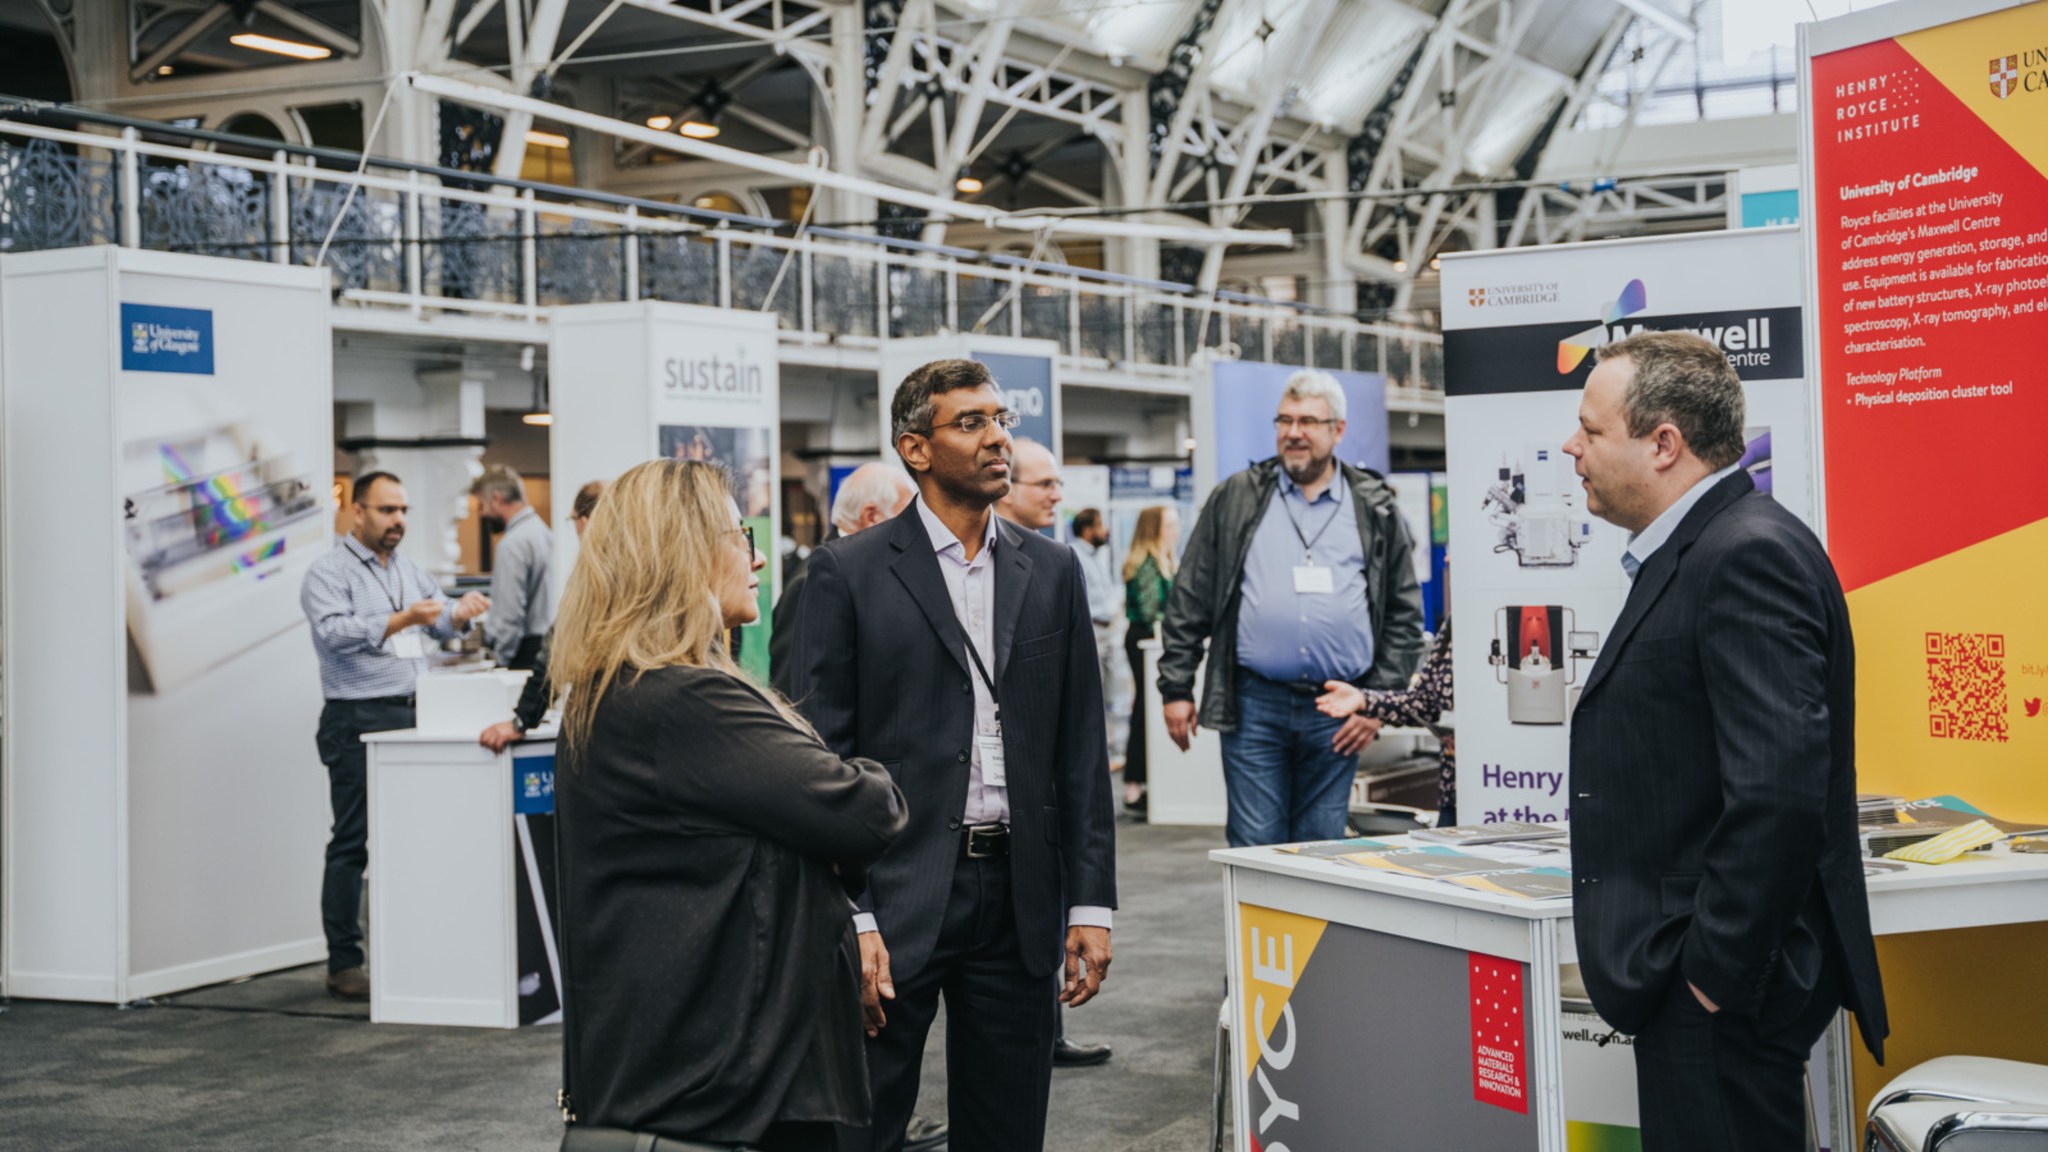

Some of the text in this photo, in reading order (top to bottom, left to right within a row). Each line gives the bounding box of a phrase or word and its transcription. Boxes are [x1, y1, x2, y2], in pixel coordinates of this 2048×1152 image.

[1836, 75, 1888, 98] HENRY
[1836, 98, 1887, 120] ROYCE
[1837, 114, 1919, 143] INSTITUTE
[1840, 165, 1978, 201] University of Cambridge
[1841, 192, 2003, 230] Royce facilities at the University
[1841, 215, 2000, 250] of Cambridge's Maxwell Centre
[1842, 228, 2047, 271] address energy generation, storage, and
[1487, 282, 1558, 295] UNIVERSITY OF
[1842, 280, 1862, 292] use.
[1863, 271, 1917, 291] Equipment
[1919, 268, 1927, 282] is
[1929, 262, 1974, 280] available
[1976, 260, 1993, 274] for
[1488, 292, 1559, 307] CAMBRIDGE
[1843, 298, 1854, 313] of
[1856, 299, 1876, 312] new
[1878, 292, 1914, 309] battery
[1916, 285, 1972, 304] structures,
[1974, 282, 2003, 298] X-ray
[1844, 317, 1911, 336] spectroscopy,
[1913, 311, 1940, 327] X-ray
[1942, 303, 2011, 323] tomography,
[2013, 298, 2034, 314] and
[1612, 317, 1770, 351] Mwell
[1845, 335, 1926, 355] characterisation.
[665, 350, 761, 394] sustain
[1723, 351, 1771, 368] entre
[1846, 365, 1942, 386] Technology Platform
[1855, 380, 2013, 408] Physical deposition cluster tool
[1483, 763, 1563, 797] Henry
[1250, 926, 1300, 1152] YCE
[1478, 1044, 1514, 1063] ADVANCED
[1478, 1055, 1514, 1074] MATERIALS
[1478, 1066, 1520, 1087] RESEARCH &
[1479, 1077, 1521, 1099] INNOVATION
